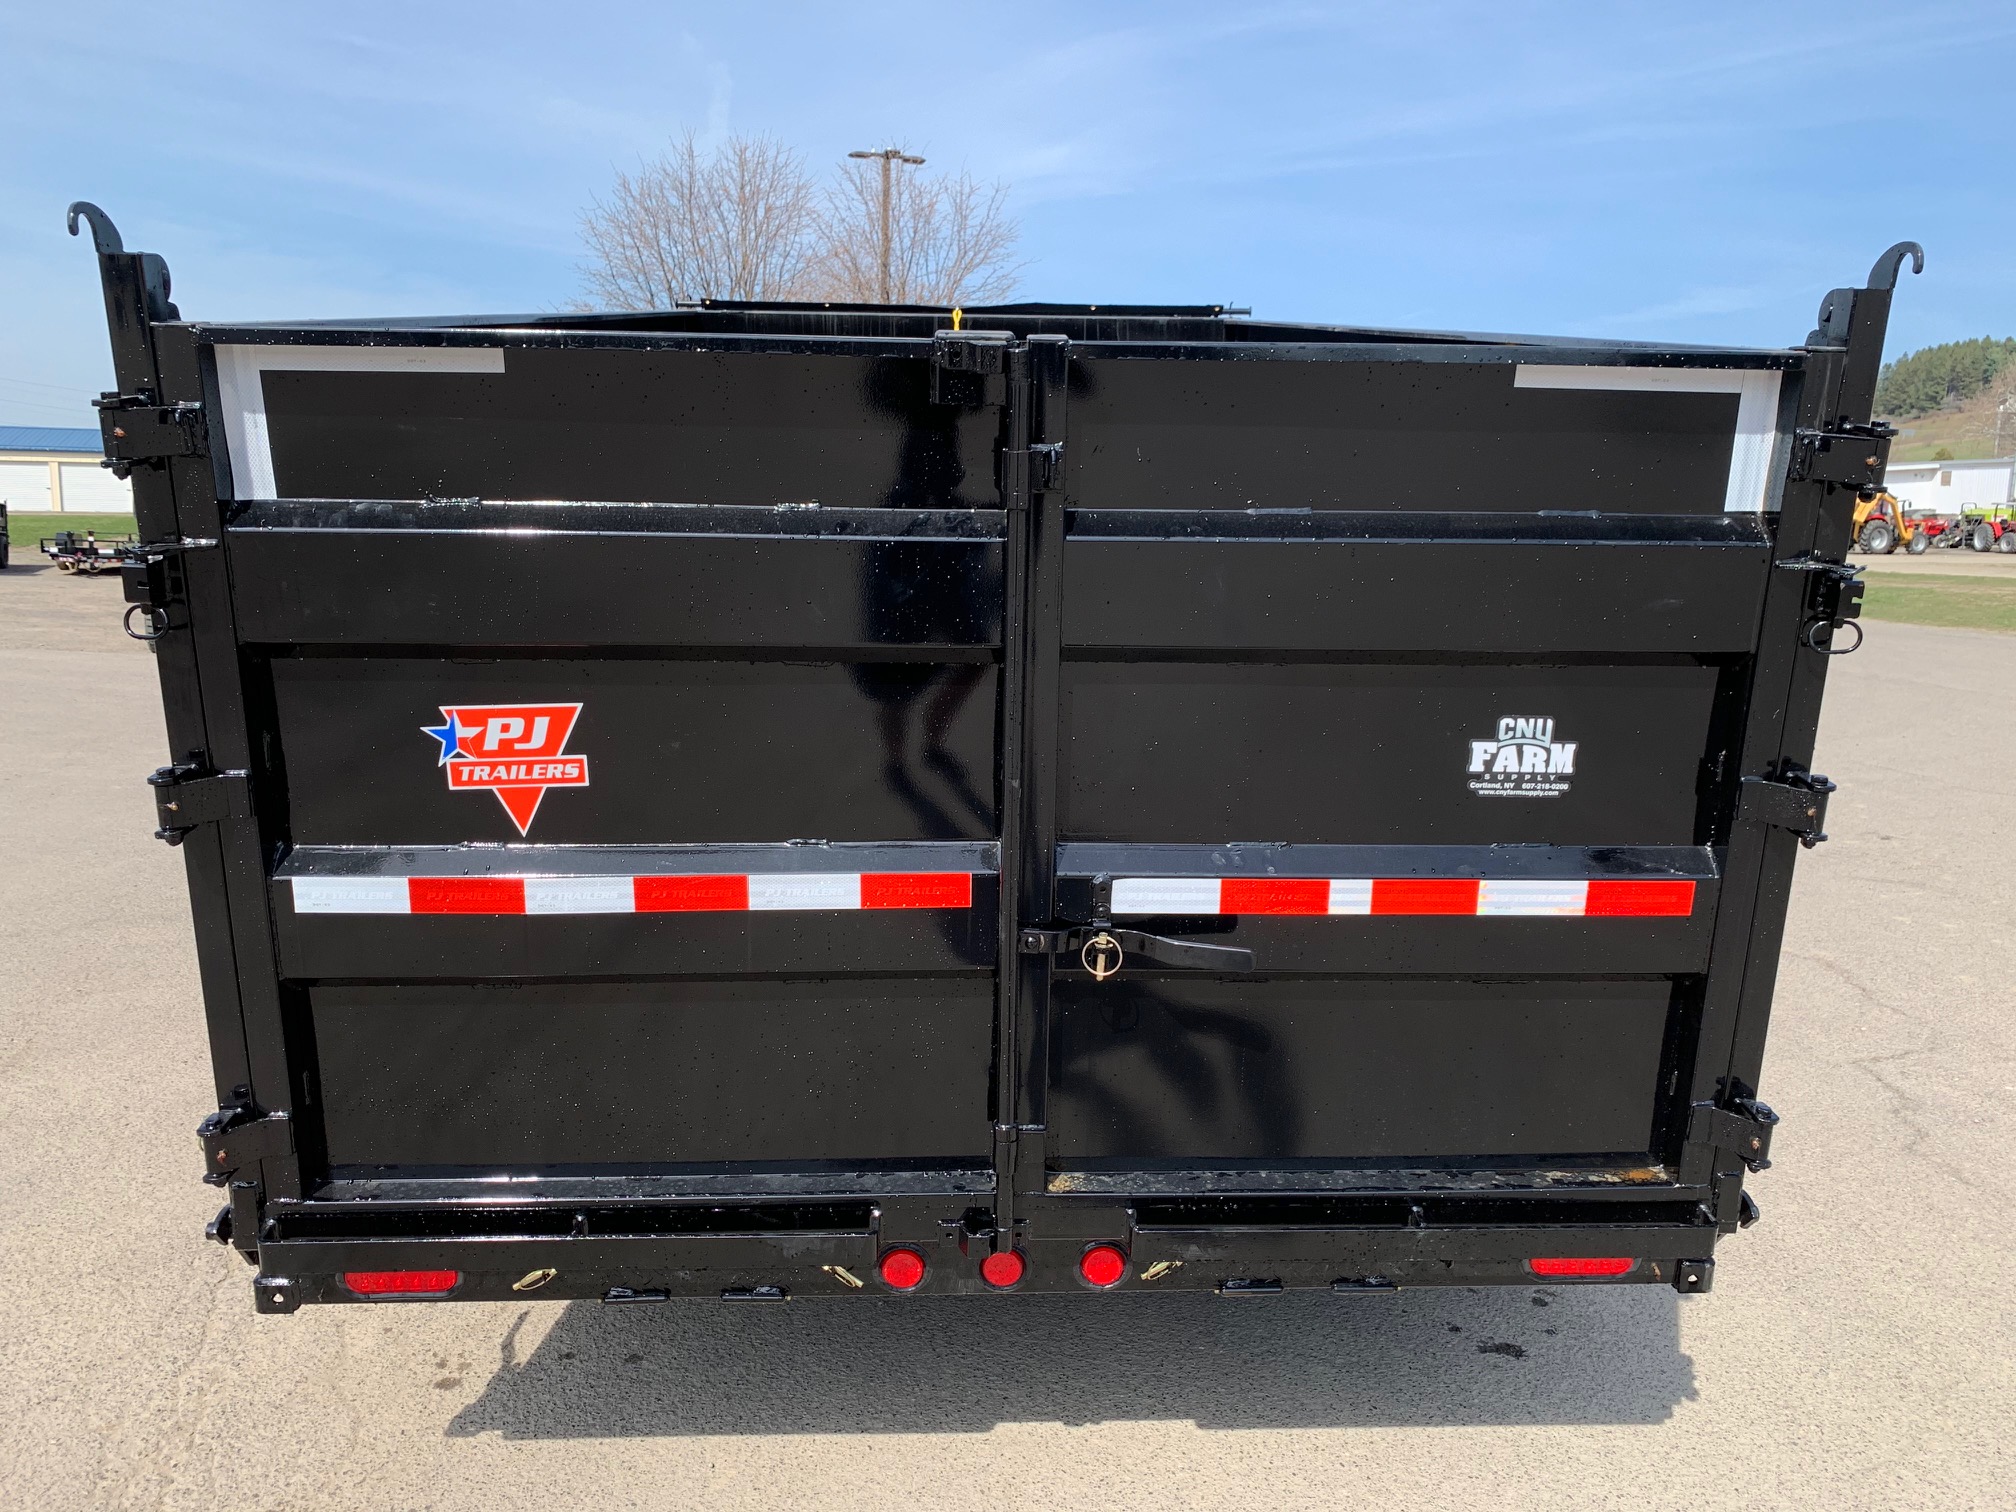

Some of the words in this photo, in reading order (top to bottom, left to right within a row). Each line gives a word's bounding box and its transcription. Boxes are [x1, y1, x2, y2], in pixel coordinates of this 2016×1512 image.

[483, 716, 550, 750] PJ
[1498, 717, 1554, 748] CNY
[1469, 741, 1577, 773] FARM
[458, 763, 580, 781] TRAILERS
[1469, 781, 1503, 790] Cortland,
[1521, 782, 1569, 790] 607-218-0200
[1478, 789, 1559, 797] www.cnyfarmsupply.com
